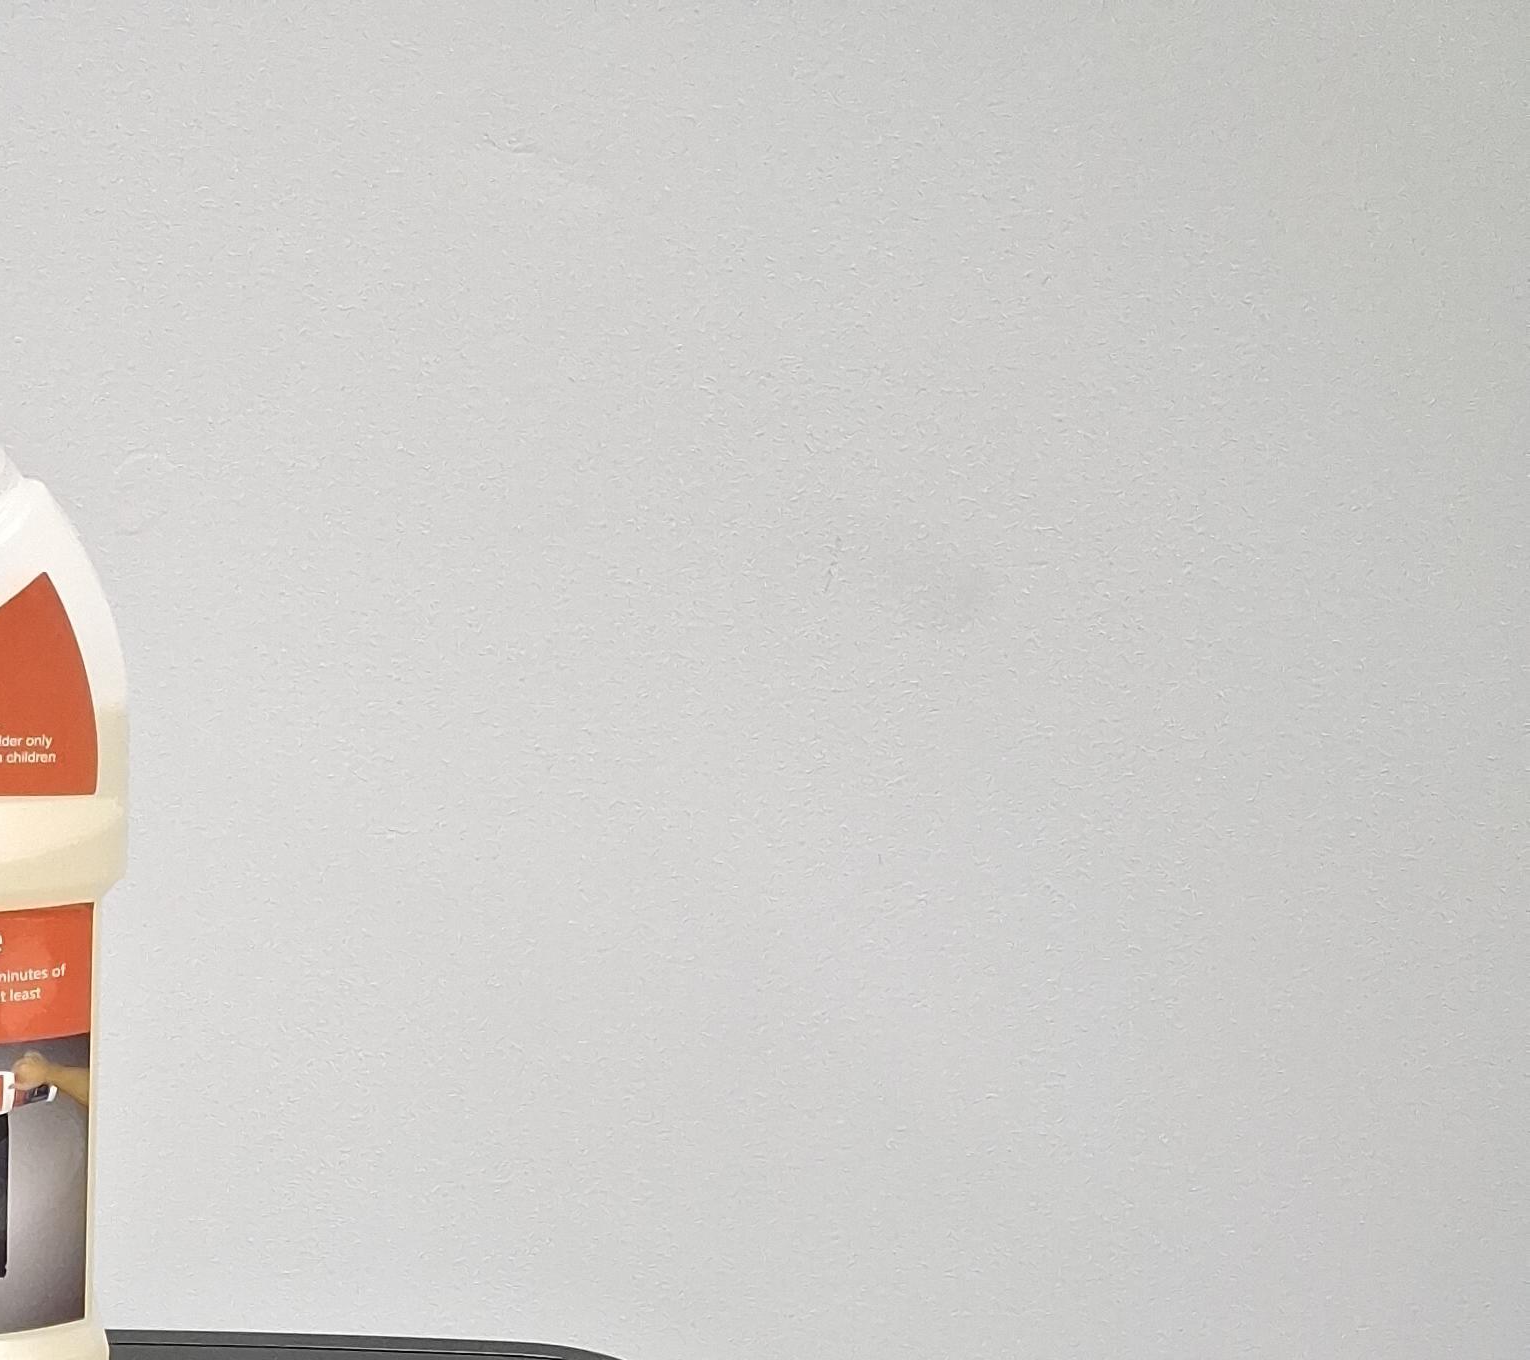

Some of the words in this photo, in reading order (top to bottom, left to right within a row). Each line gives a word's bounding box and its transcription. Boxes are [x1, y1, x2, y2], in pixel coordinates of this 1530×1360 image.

[25, 734, 52, 749] only
[6, 751, 56, 764] children
[52, 963, 67, 977] of
[10, 987, 42, 1002] least
